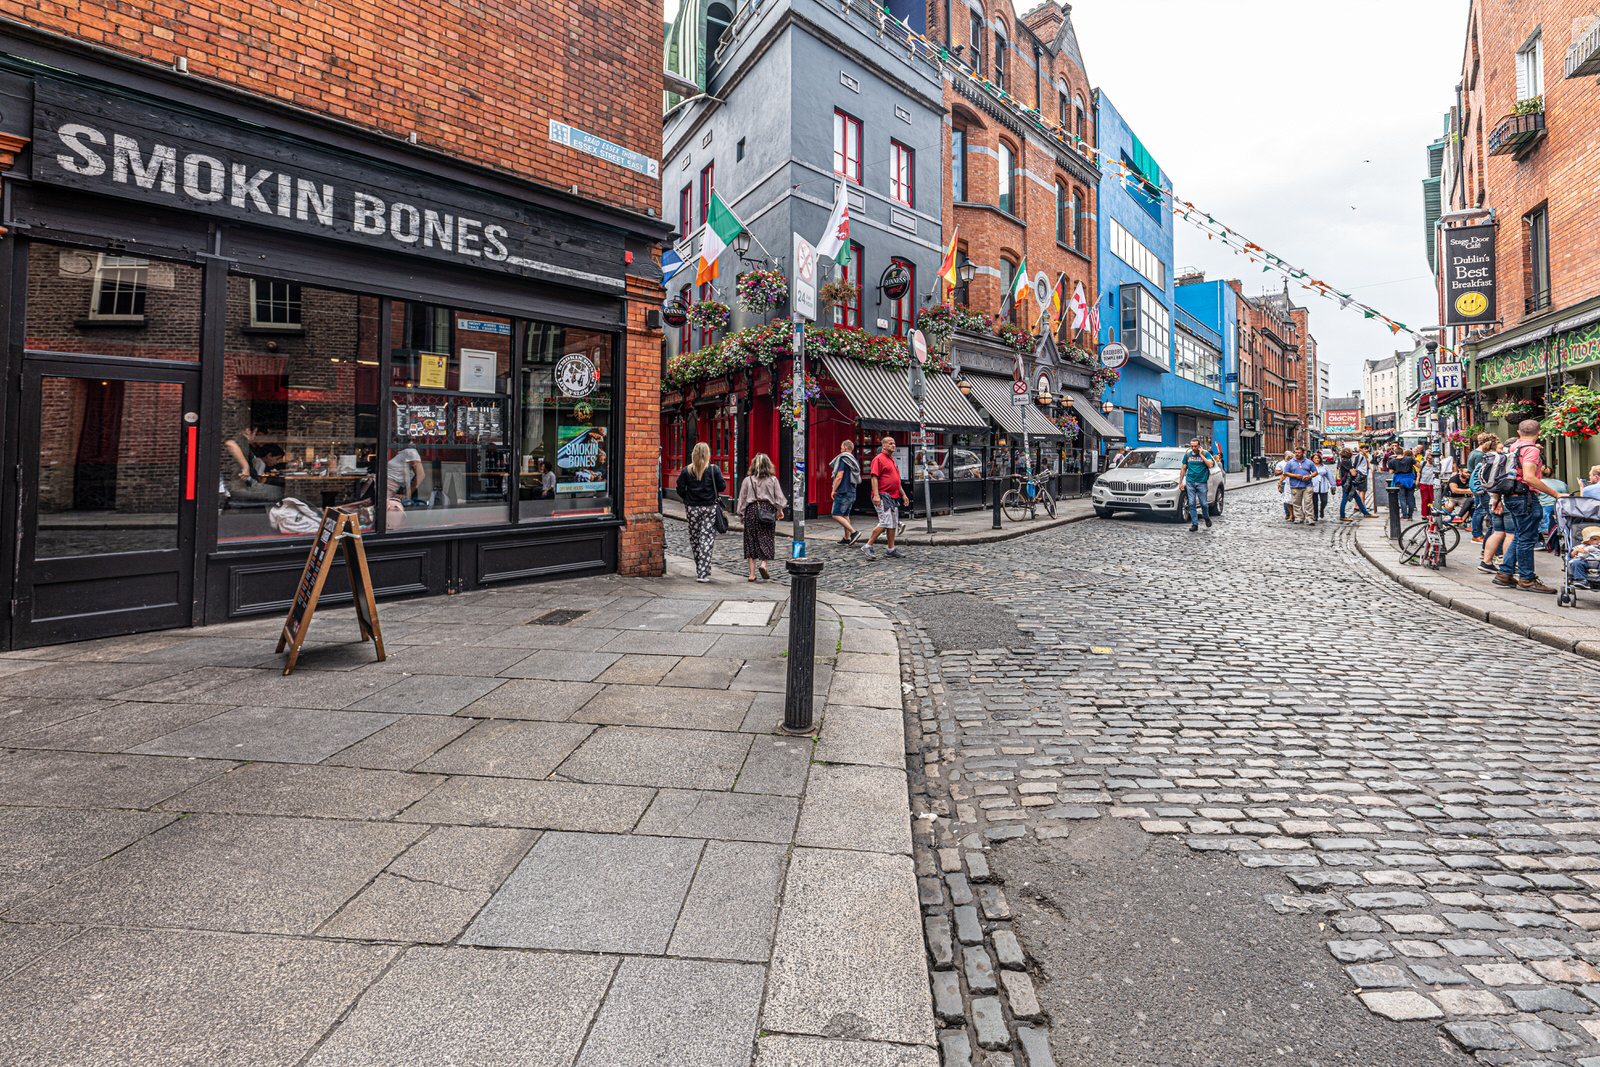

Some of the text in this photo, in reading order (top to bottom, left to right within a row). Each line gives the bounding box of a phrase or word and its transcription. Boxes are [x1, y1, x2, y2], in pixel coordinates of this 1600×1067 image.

[602, 141, 620, 154] ESSEX
[573, 139, 644, 171] ESSEX STREET EAST
[650, 164, 656, 173] 2
[56, 122, 509, 262] SMOKIN BONES
[1450, 238, 1469, 247] Stage
[1453, 254, 1490, 265] Dublin's
[1455, 266, 1489, 280] Best
[1451, 279, 1493, 290] Breakfast
[798, 289, 806, 304] 24
[1442, 365, 1458, 373] DOOR
[1511, 358, 1533, 379] you
[566, 443, 599, 456] SMOKIN
[569, 455, 596, 468] BONES
